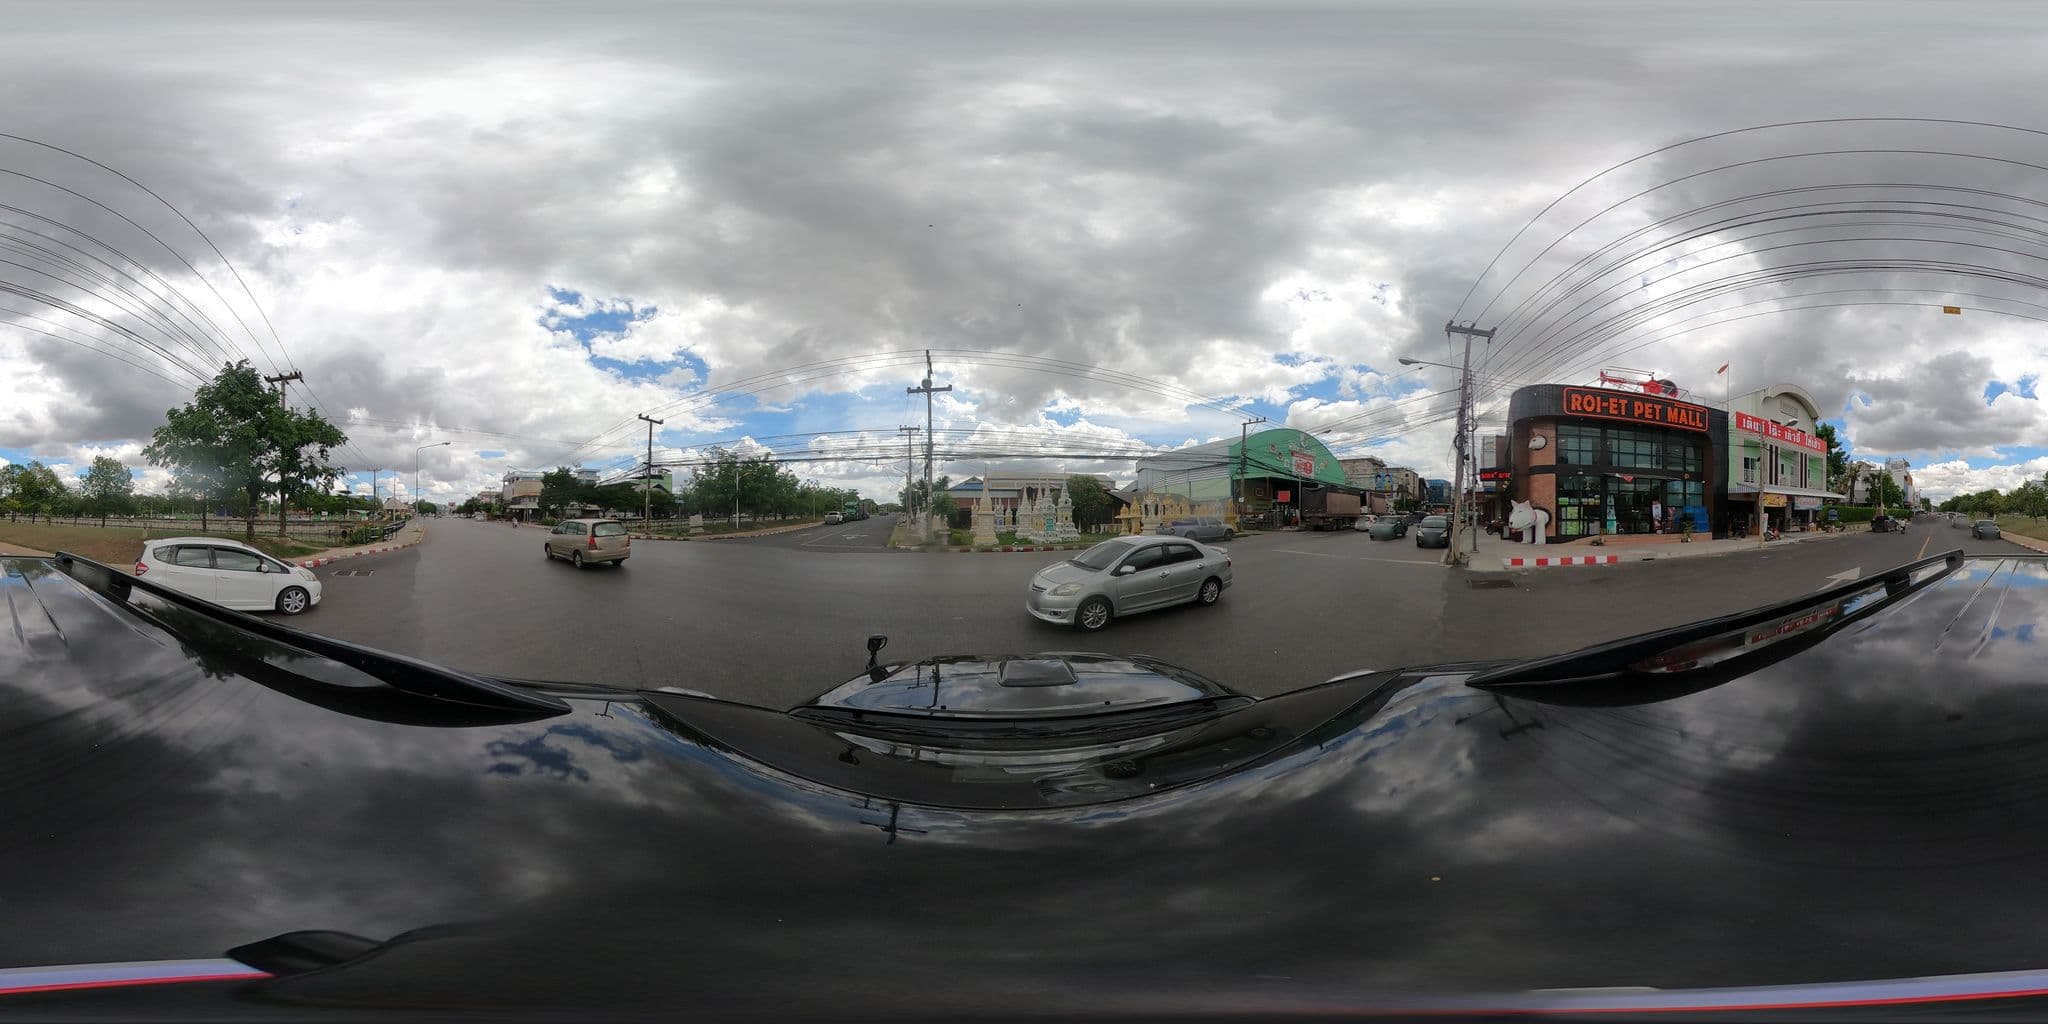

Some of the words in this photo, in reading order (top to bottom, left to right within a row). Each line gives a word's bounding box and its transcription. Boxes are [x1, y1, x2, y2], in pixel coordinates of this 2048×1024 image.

[1570, 393, 1627, 416] ROI-ET
[1634, 401, 1662, 420] PET
[1667, 406, 1703, 427] MALL
